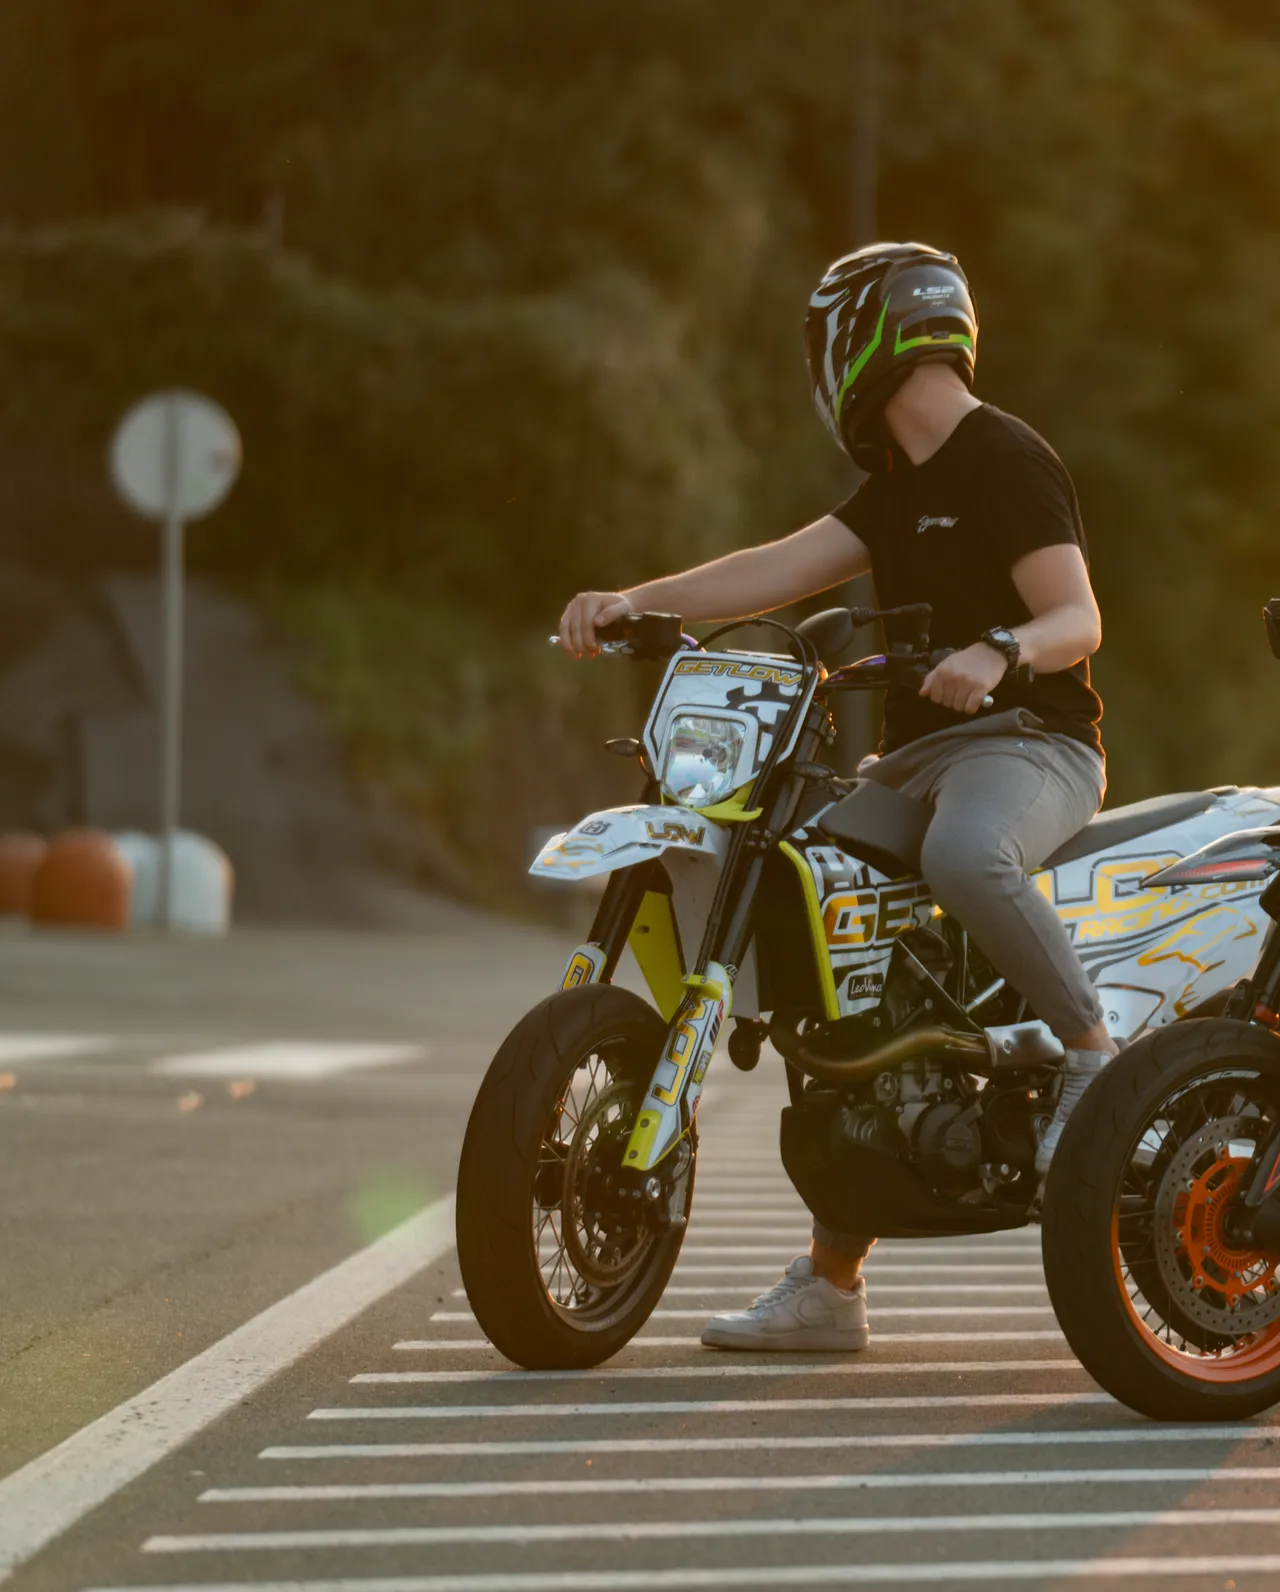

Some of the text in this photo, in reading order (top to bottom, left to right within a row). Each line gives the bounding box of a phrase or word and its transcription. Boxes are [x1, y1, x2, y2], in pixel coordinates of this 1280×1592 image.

[913, 286, 955, 296] LS2
[674, 660, 803, 686] GETLOW
[645, 820, 706, 846] LOW
